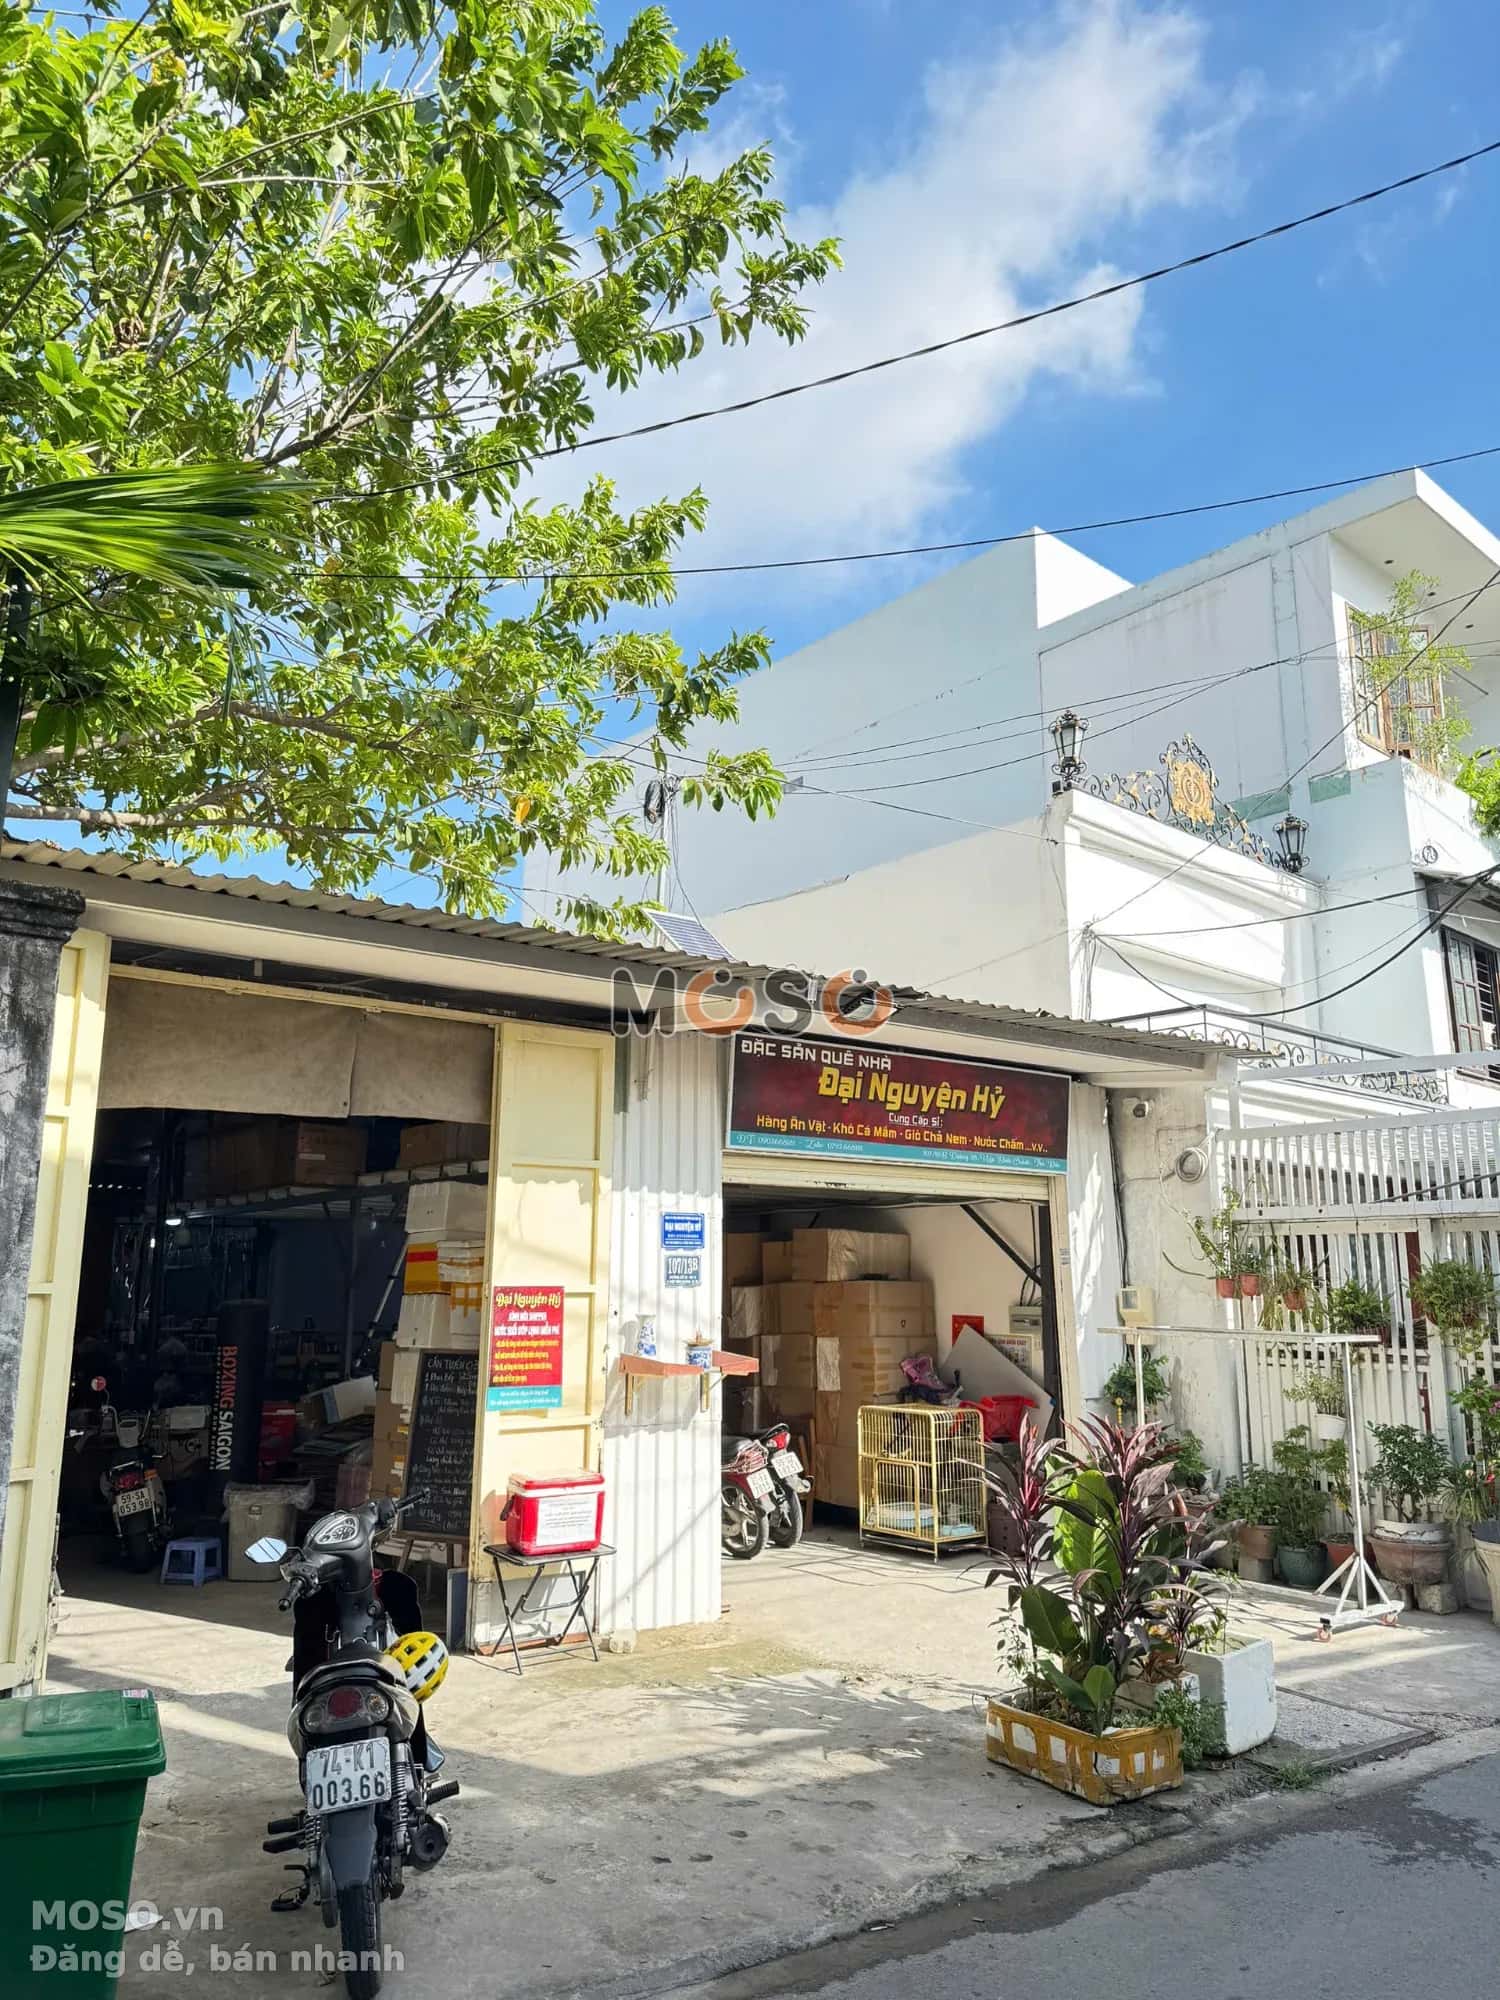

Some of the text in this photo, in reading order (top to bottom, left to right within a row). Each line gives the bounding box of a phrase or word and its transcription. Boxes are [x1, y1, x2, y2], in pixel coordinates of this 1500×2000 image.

[741, 1038, 892, 1071] ĐẶC SẢN QUÊ NHÀ
[818, 1066, 1006, 1119] Đại Nguyện Hỷ
[756, 1114, 787, 1132] Hàng
[790, 1115, 806, 1130] Ăn
[923, 1130, 943, 1143] Chả
[945, 1133, 968, 1145] Nem
[888, 1112, 910, 1125] Cung
[215, 1345, 239, 1471] BOXING SAIGON
[319, 1741, 375, 1778] 74-K1
[312, 1771, 386, 1810] 003.66
